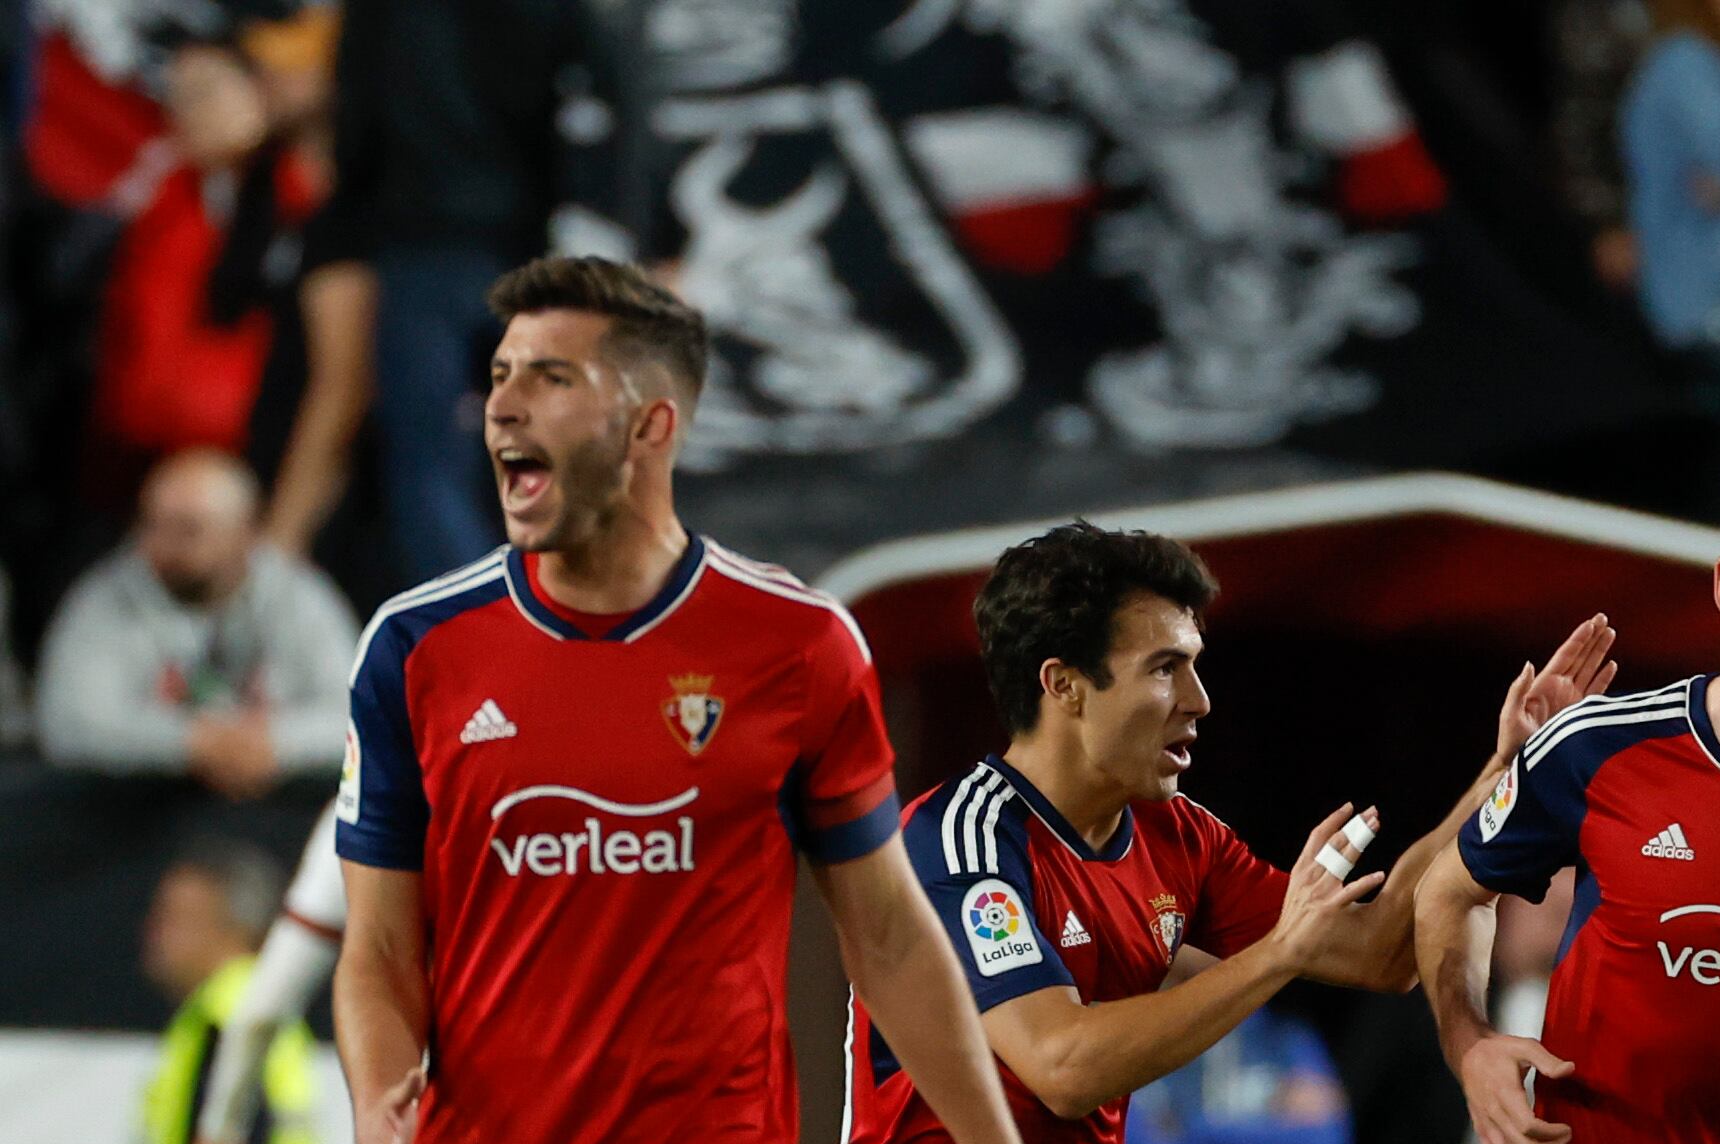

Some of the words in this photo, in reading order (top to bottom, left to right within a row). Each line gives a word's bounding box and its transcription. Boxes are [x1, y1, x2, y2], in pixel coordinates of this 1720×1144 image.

[490, 816, 694, 877] verleal
[1641, 844, 1695, 861] adidas
[1060, 931, 1092, 948] adidas
[982, 941, 1034, 964] LaLiga
